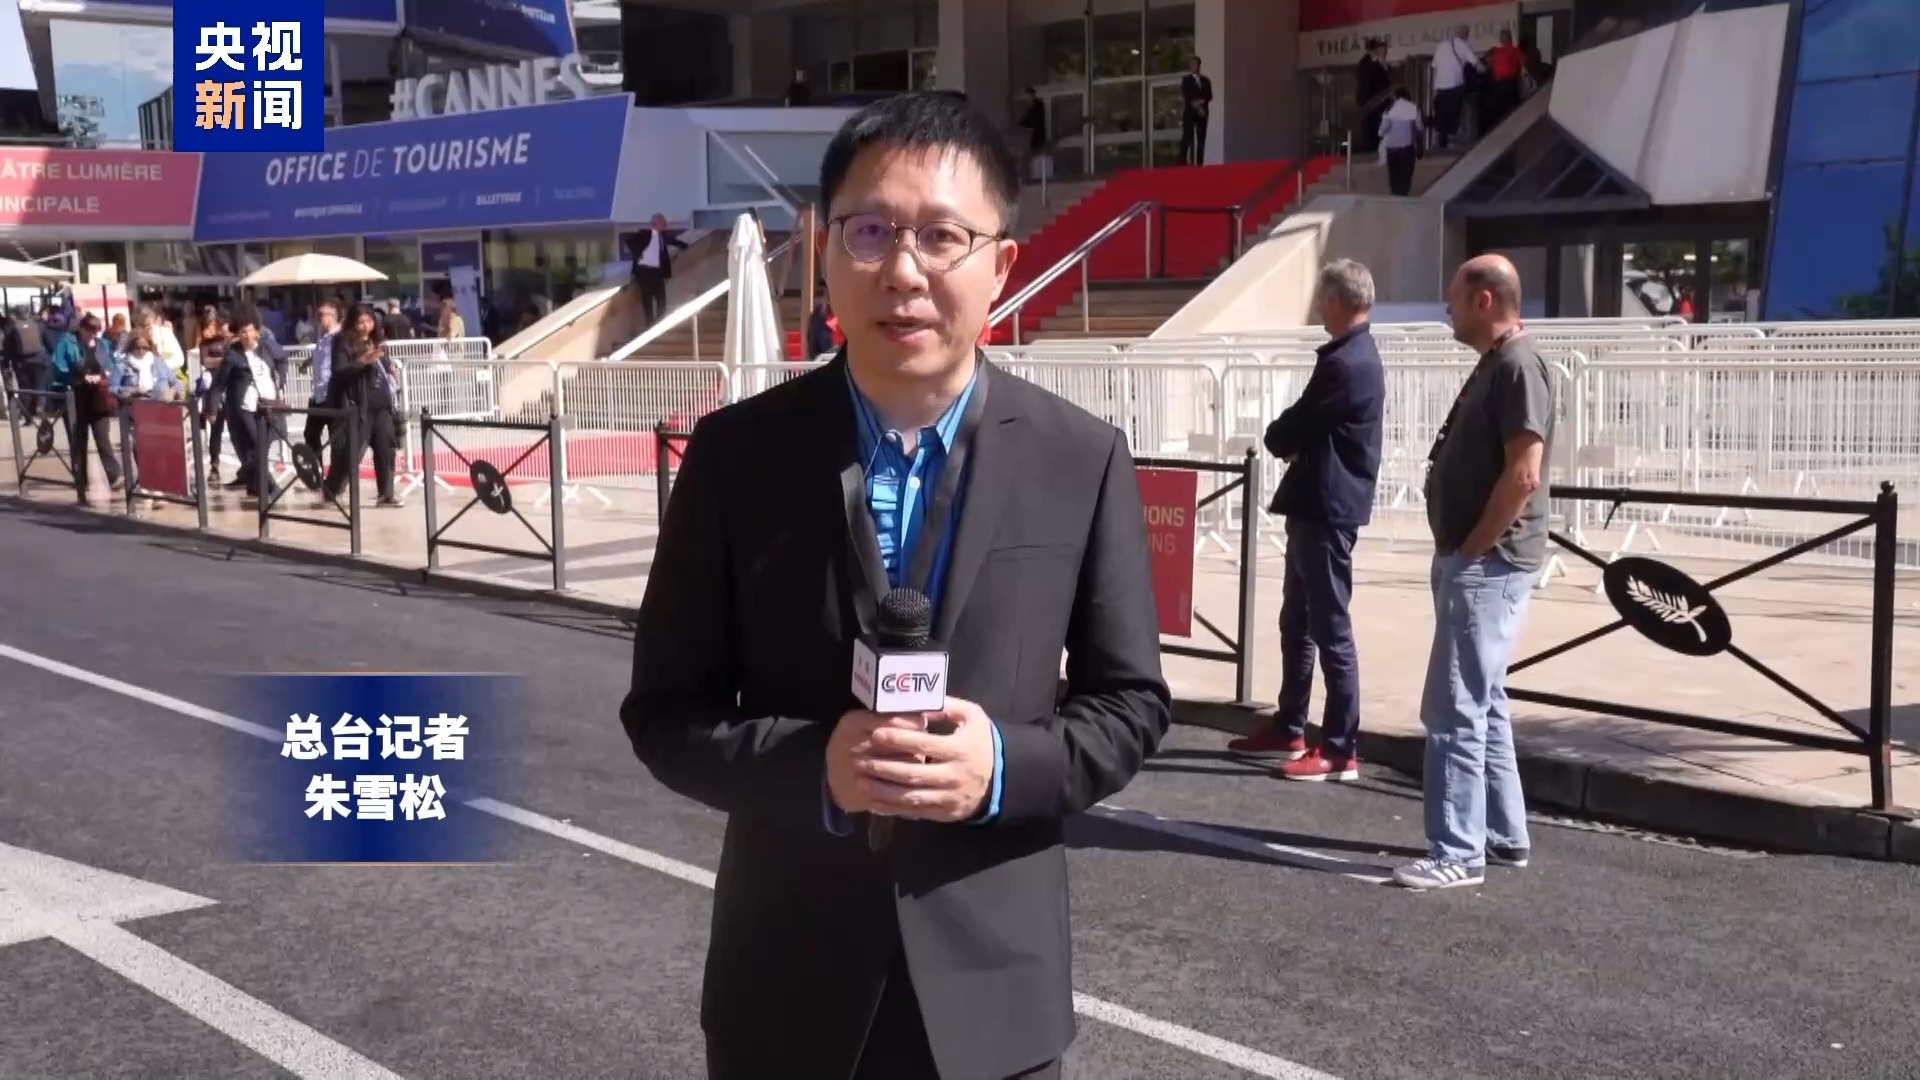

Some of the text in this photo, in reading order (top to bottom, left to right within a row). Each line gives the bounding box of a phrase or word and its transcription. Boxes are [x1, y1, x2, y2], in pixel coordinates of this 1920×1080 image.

[265, 132, 532, 186] OFFICE DE TOURISME
[66, 160, 163, 181] LUMIÈRE
[881, 672, 940, 693] CCTV
